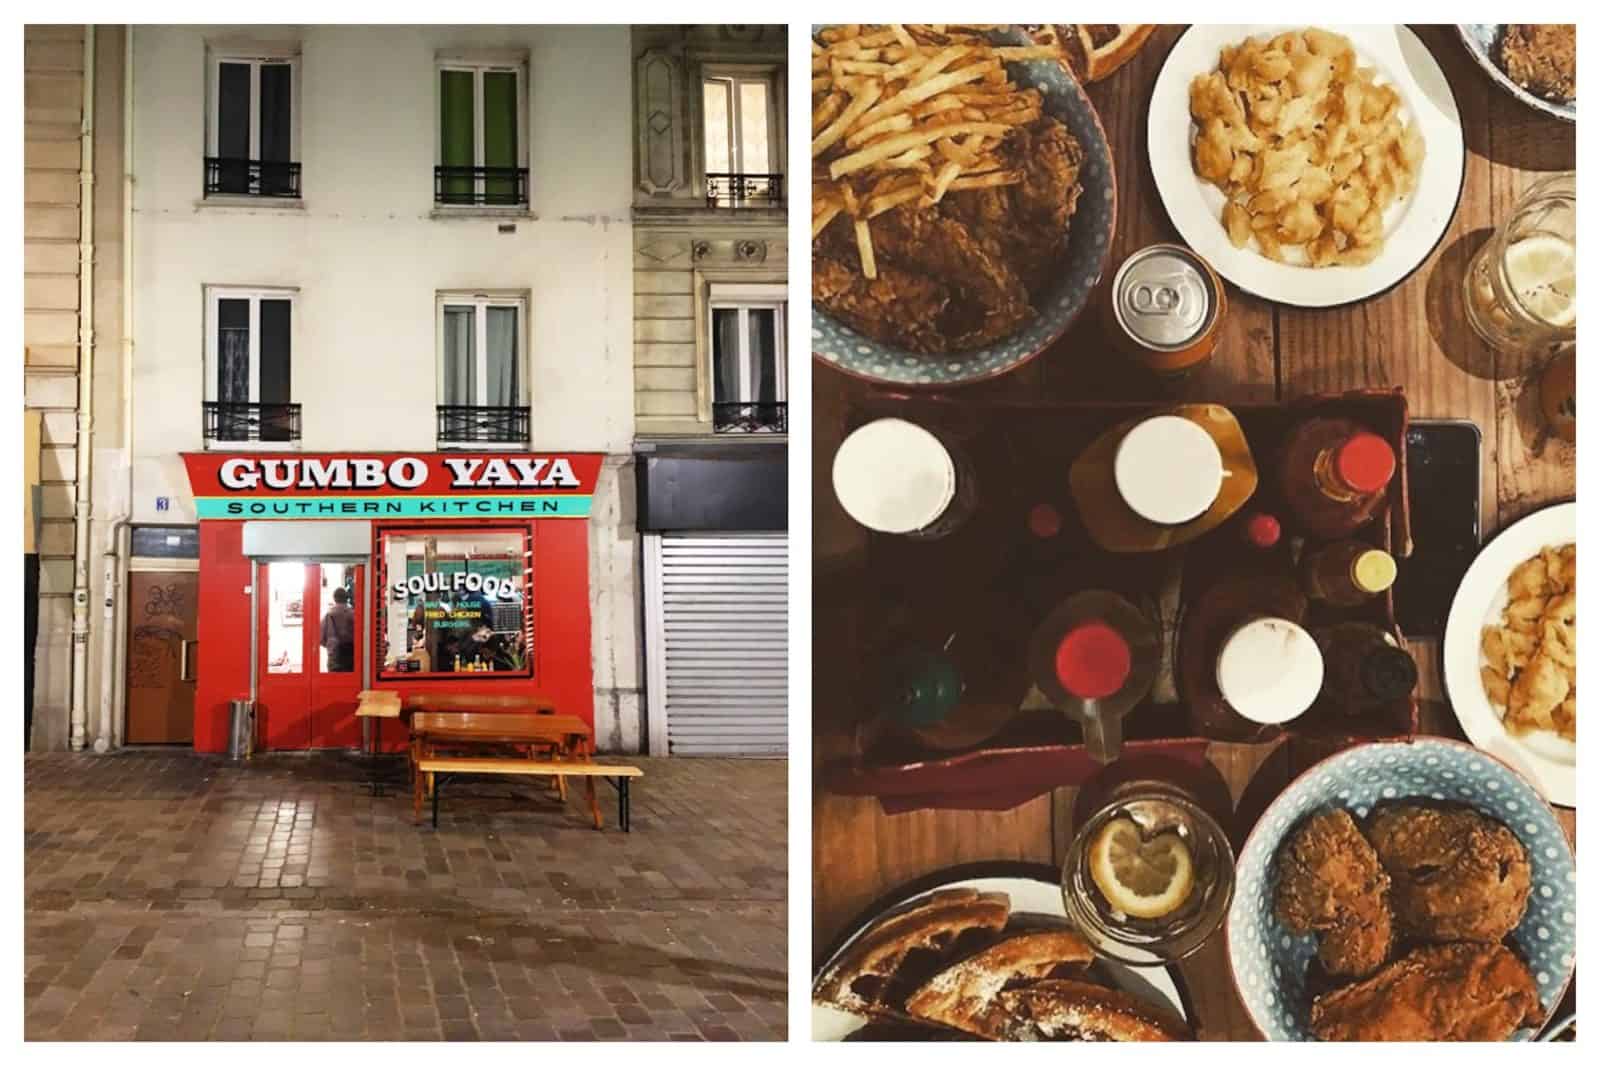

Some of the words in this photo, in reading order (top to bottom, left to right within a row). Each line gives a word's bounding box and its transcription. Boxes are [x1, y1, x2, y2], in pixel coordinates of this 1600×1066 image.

[220, 458, 429, 489] GUMBO
[446, 458, 581, 488] YAYA
[227, 501, 402, 515] SOUTHERN
[420, 500, 560, 513] KITCHEN
[394, 571, 450, 600] SOUL
[453, 572, 516, 599] FOOD
[449, 610, 481, 618] CHICKEN
